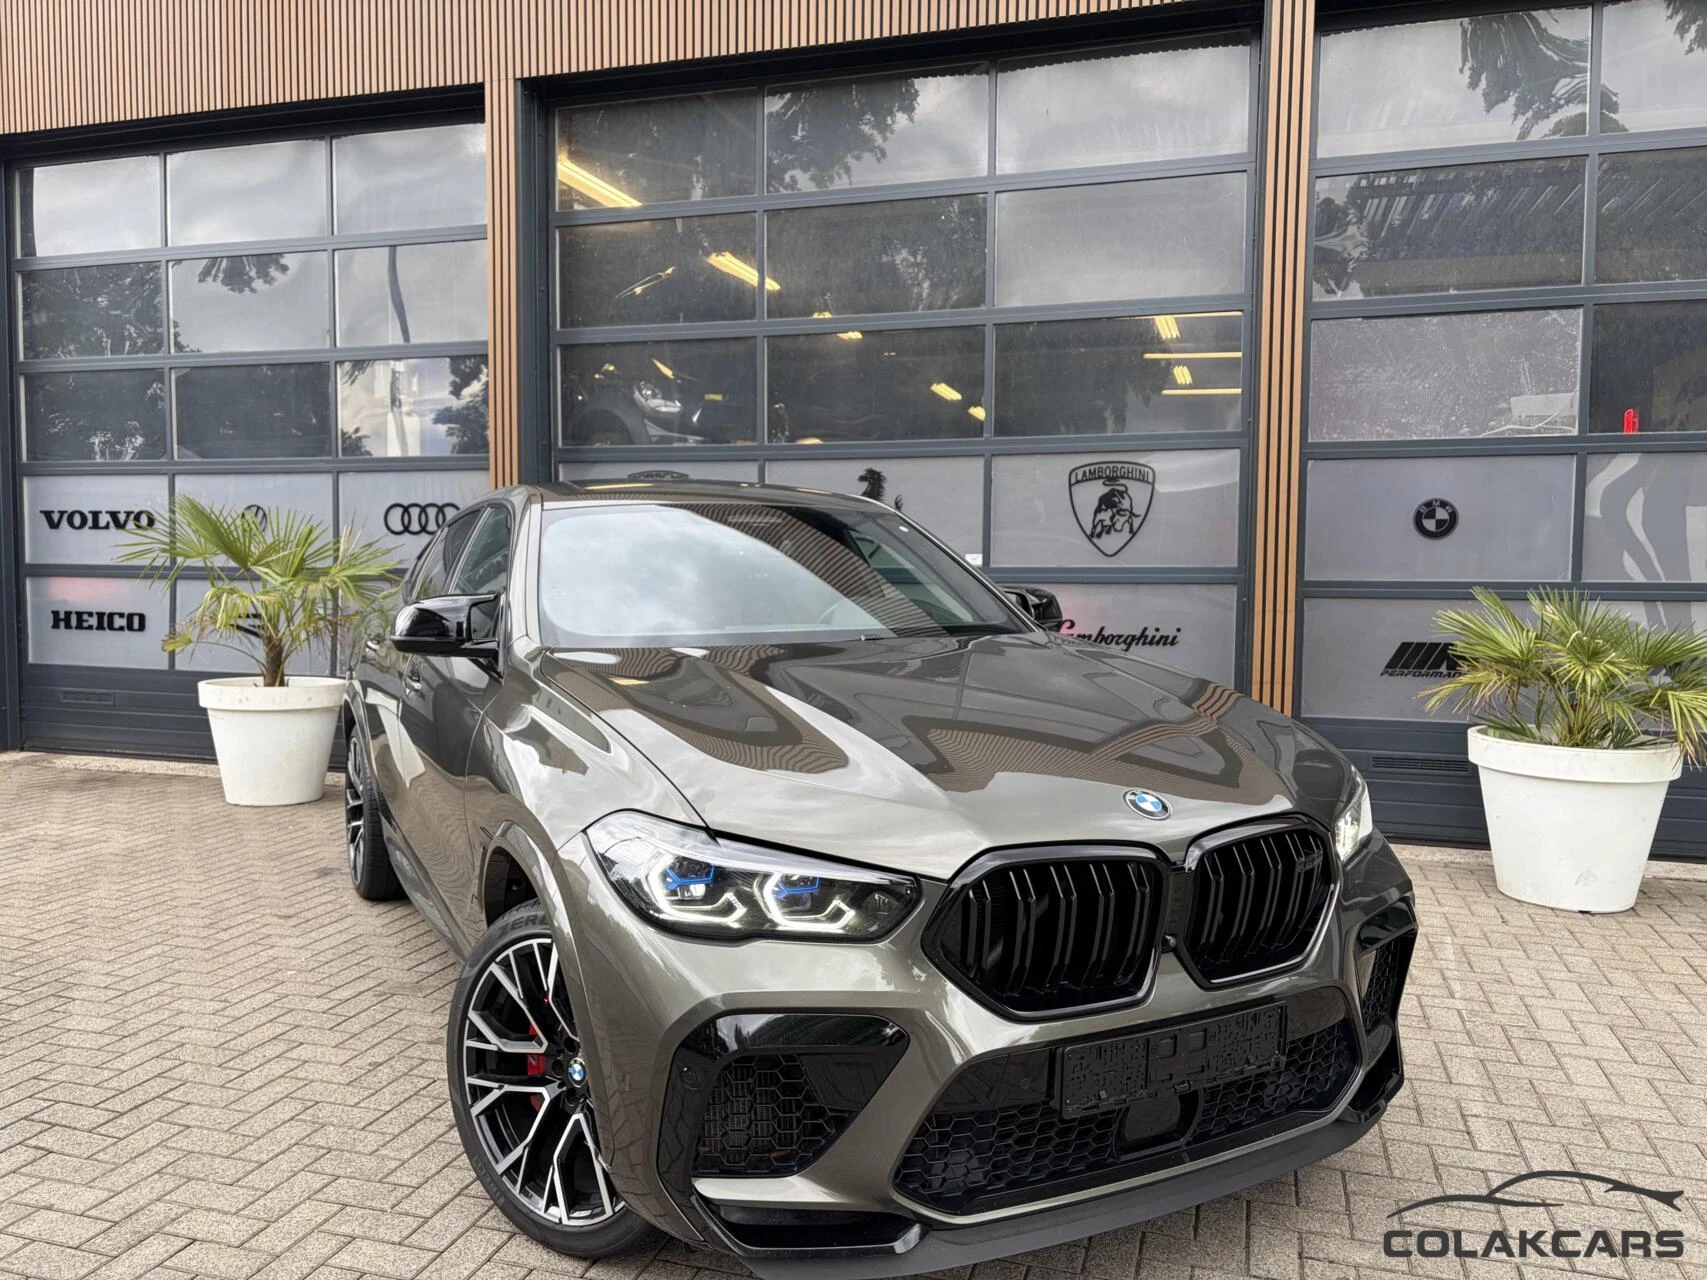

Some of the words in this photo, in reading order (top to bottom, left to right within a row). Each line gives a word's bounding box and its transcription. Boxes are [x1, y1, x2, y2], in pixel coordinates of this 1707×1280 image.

[1074, 465, 1149, 483] LAMBORGHINI
[40, 509, 156, 531] VOLVO
[50, 609, 146, 632] HEICO
[1380, 669, 1464, 679] PERFORMAN
